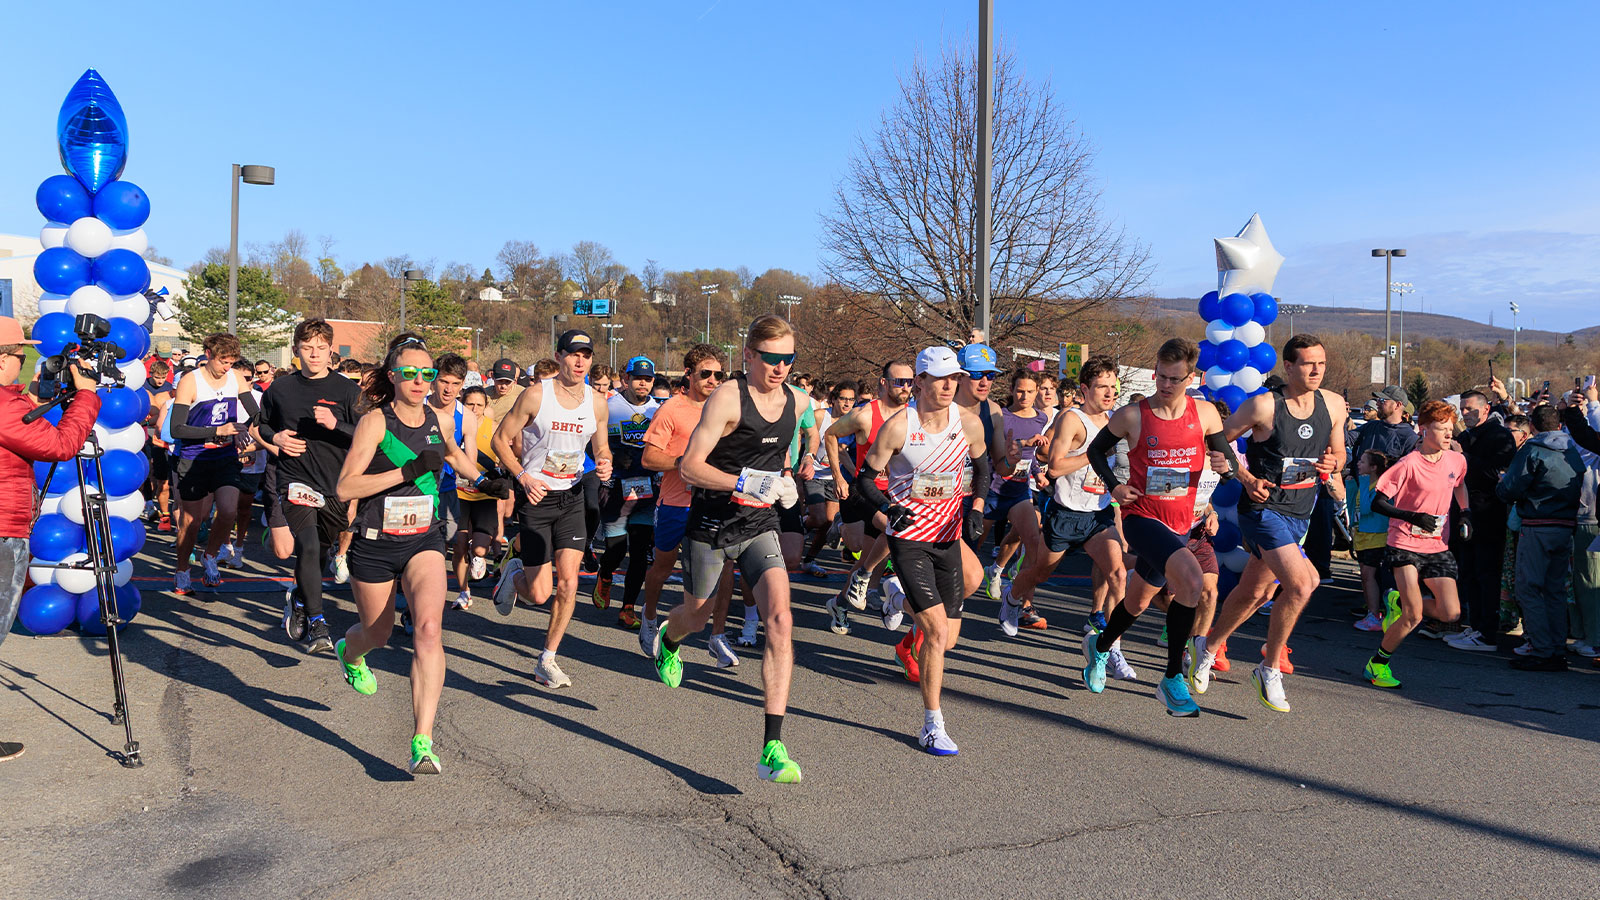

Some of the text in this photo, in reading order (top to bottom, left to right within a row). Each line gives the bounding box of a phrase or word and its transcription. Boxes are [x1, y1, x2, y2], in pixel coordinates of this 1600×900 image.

[551, 421, 584, 434] BHTC
[761, 436, 779, 444] BANDIT
[1147, 446, 1197, 458] RED ROSE
[559, 463, 567, 473] 2
[1296, 471, 1307, 481] 13
[923, 486, 944, 497] 384
[1165, 482, 1172, 493] 3
[296, 491, 319, 504] 1452
[402, 513, 417, 526] 10
